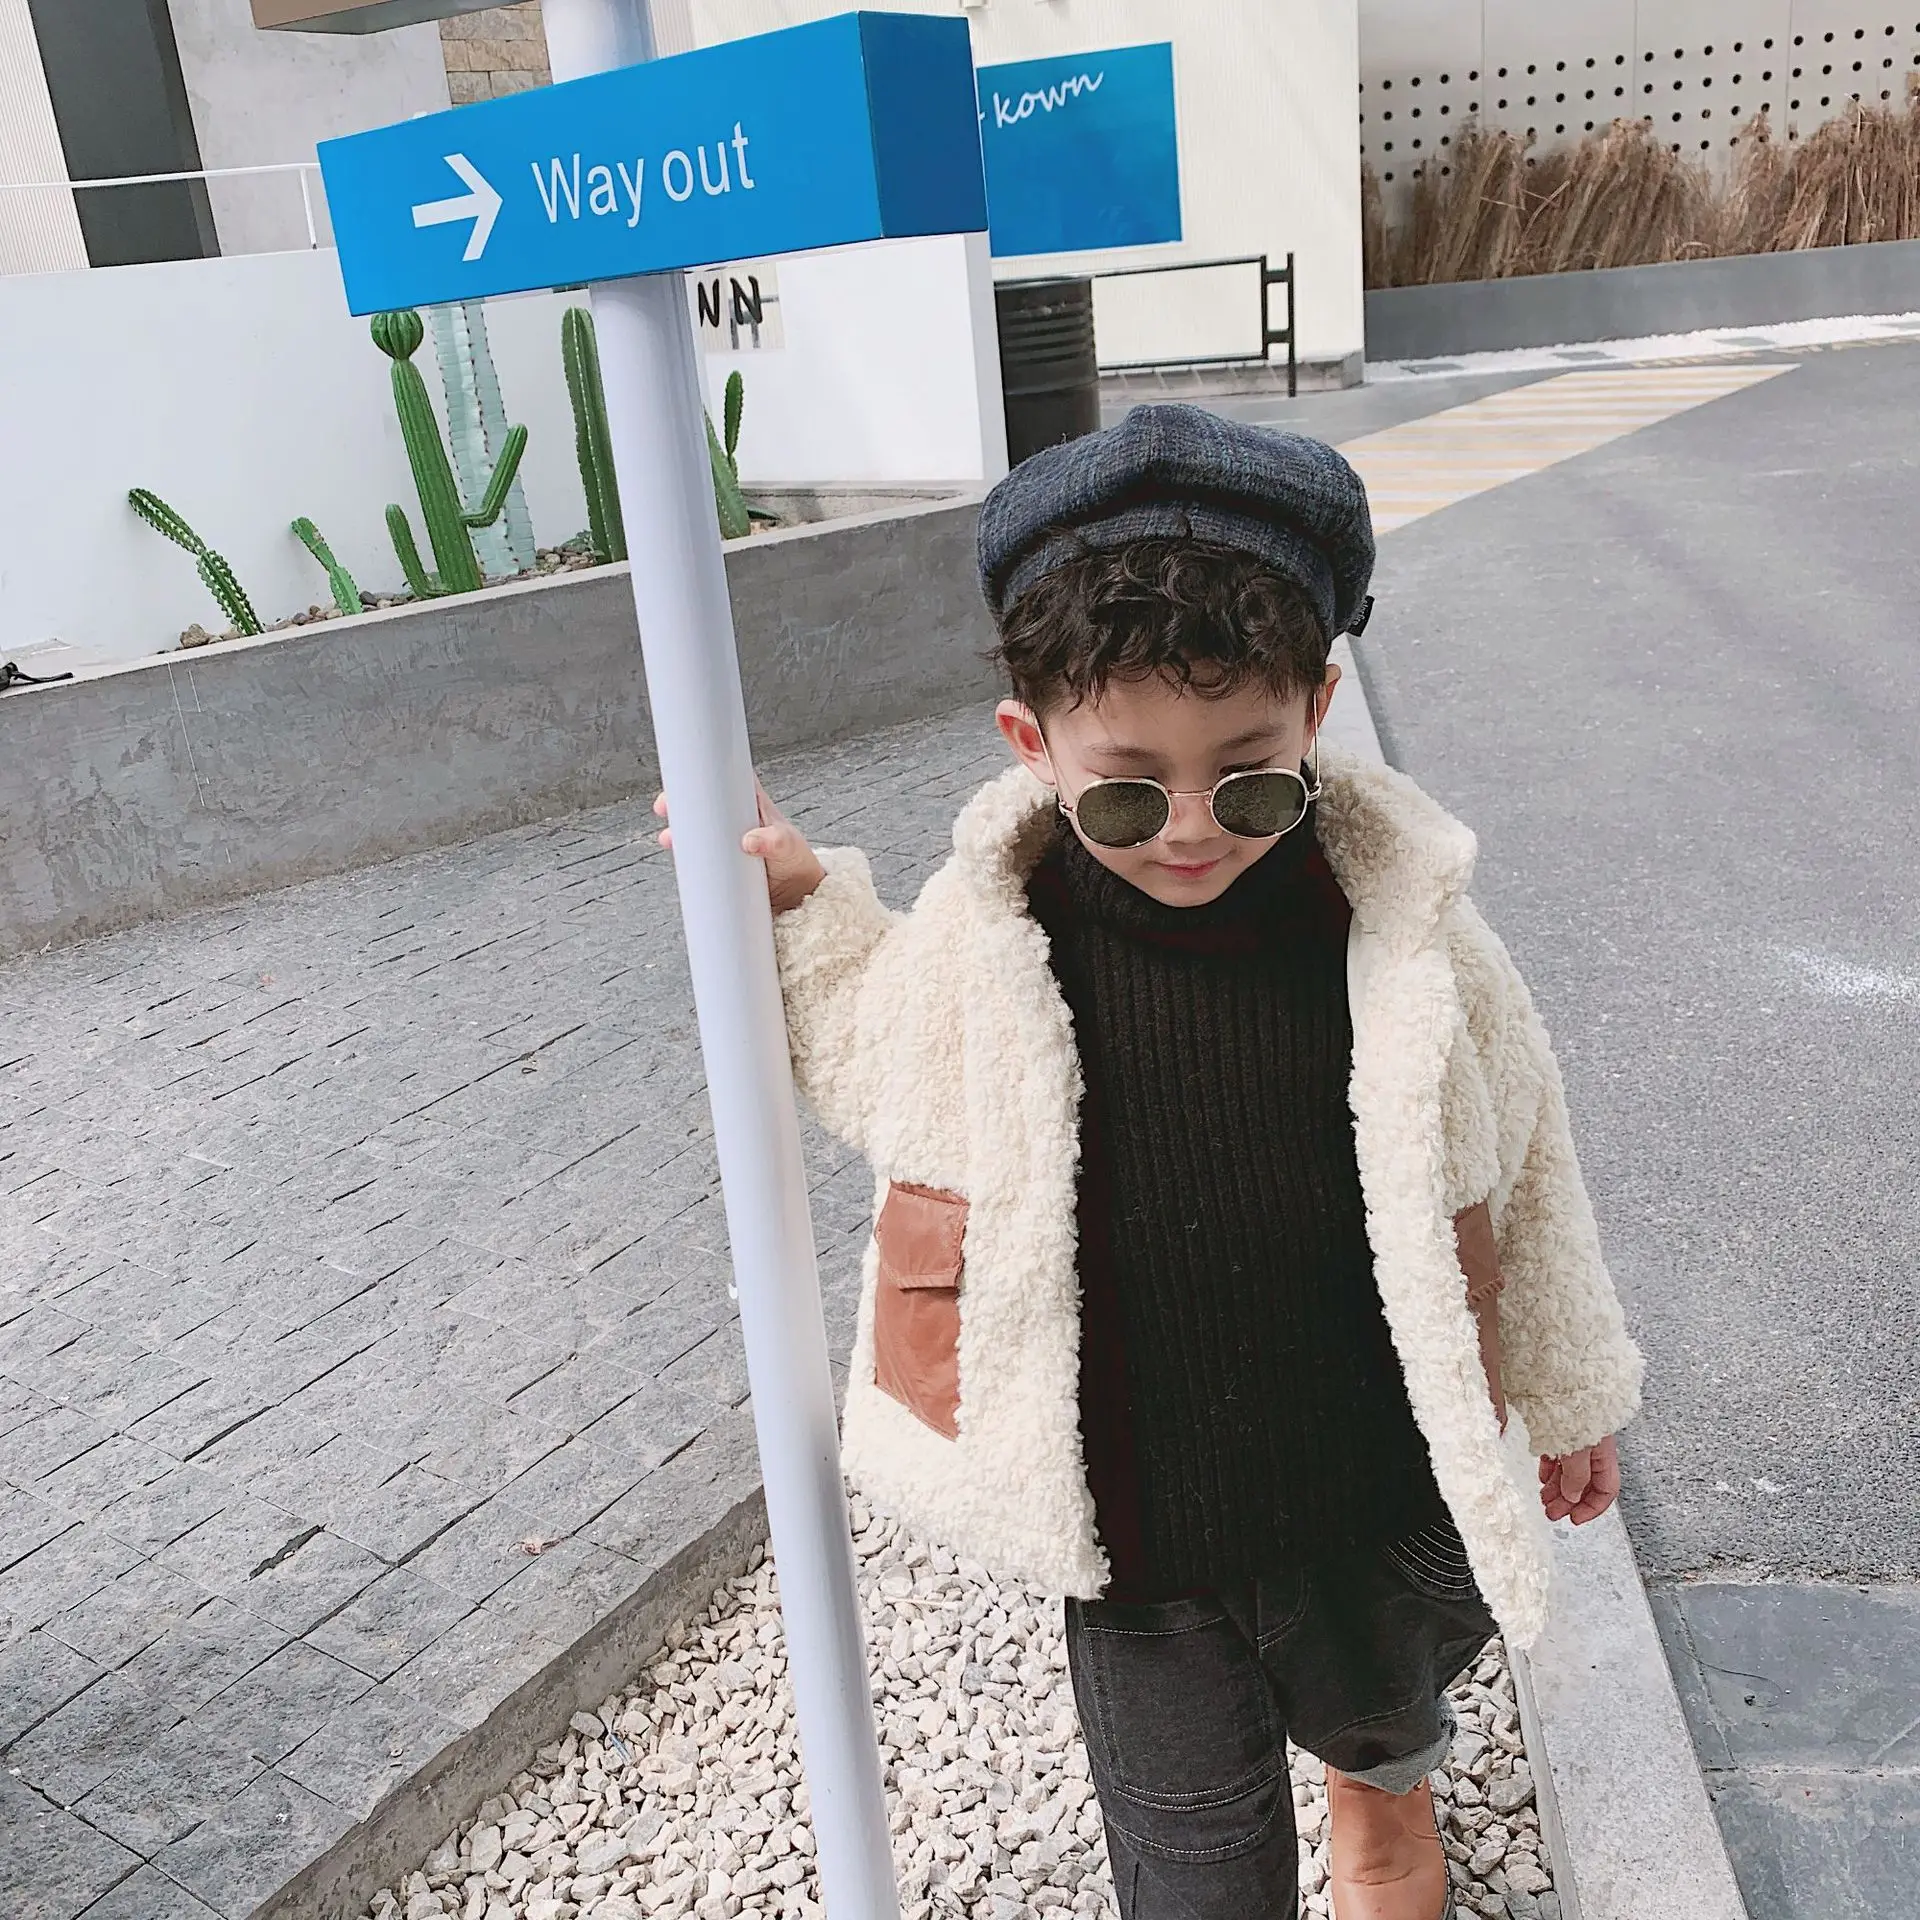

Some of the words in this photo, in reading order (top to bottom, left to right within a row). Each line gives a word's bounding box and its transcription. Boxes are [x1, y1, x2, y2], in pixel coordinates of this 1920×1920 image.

[993, 72, 1104, 128] kown
[532, 153, 644, 228] Way
[662, 121, 755, 202] out
